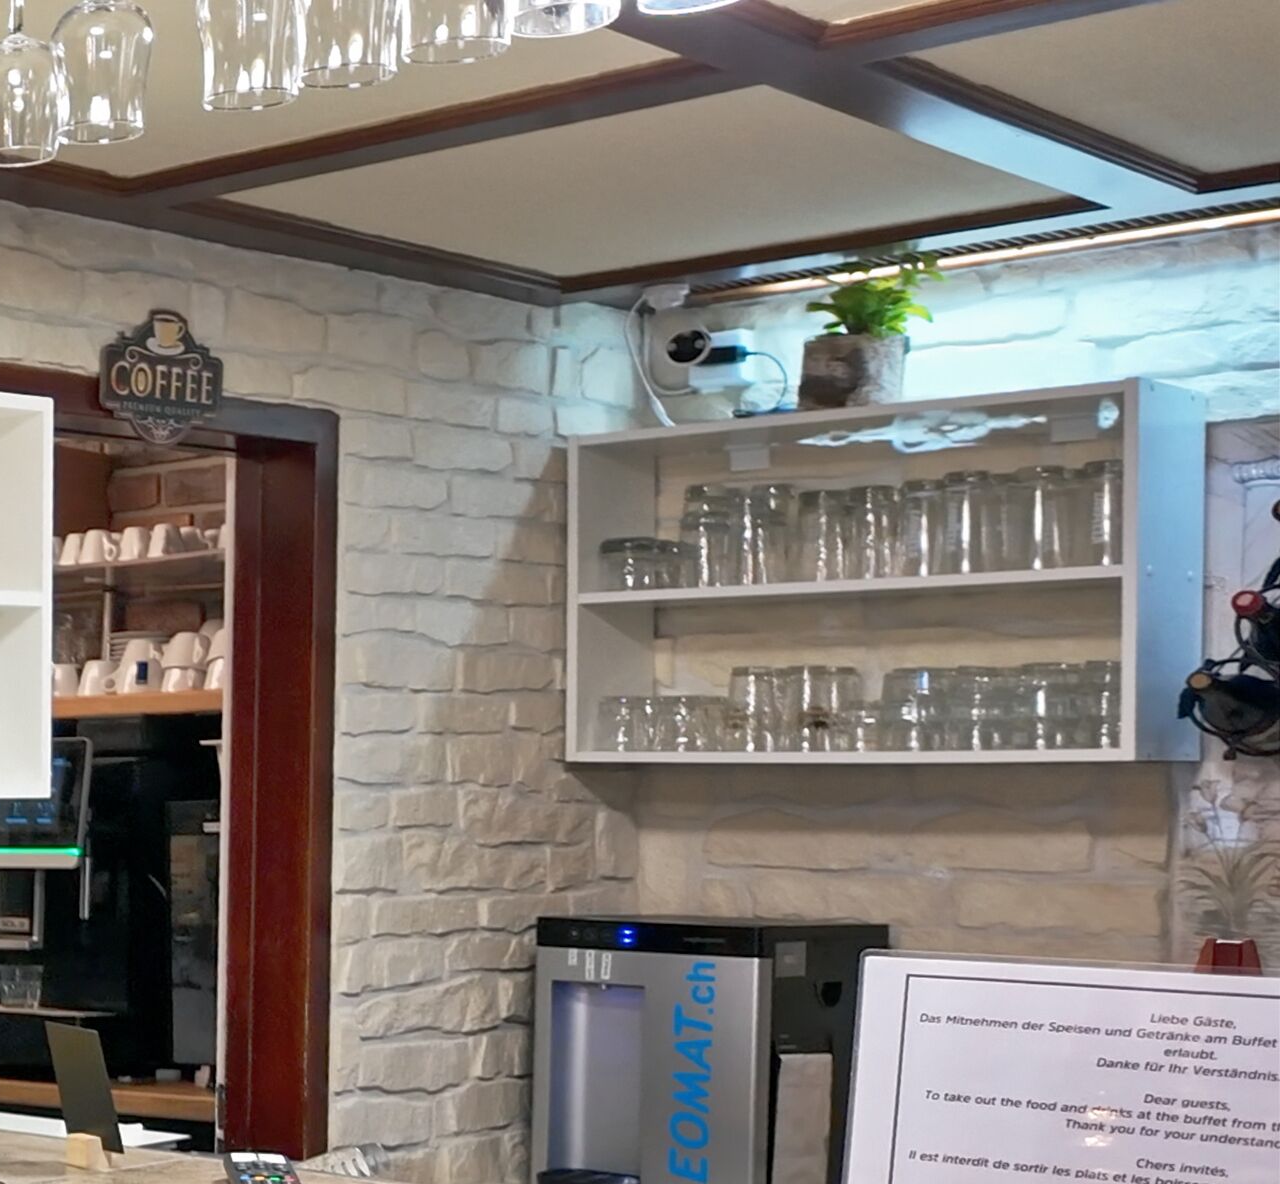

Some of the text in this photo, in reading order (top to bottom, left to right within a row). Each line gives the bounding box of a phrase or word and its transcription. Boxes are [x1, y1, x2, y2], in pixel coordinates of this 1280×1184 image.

[111, 361, 213, 404] COFFEE
[1150, 1013, 1188, 1025] Liebe
[920, 1013, 1278, 1048] Das Mitnehmen der Speisen und Getränke am Buffet
[1163, 1047, 1218, 1061] erlaubt.
[1096, 1057, 1140, 1071] Danke
[1144, 1061, 1165, 1072] für
[1168, 1063, 1188, 1075] Ihr
[925, 1089, 940, 1101] To
[943, 1092, 971, 1104] take
[975, 1096, 997, 1106] out
[1000, 1098, 1022, 1109] the
[1026, 1099, 1057, 1112] food
[1060, 1103, 1087, 1115] and
[1136, 1109, 1151, 1121] at
[1156, 1111, 1179, 1123] the
[1184, 1113, 1228, 1128] buffet
[1231, 1118, 1266, 1131] from
[1143, 1093, 1231, 1112] Dear guests,
[1065, 1118, 1105, 1132] Thank
[1109, 1124, 1135, 1135] you
[1139, 1125, 1160, 1137] for
[1164, 1130, 1197, 1142] your
[919, 1152, 939, 1163] est
[942, 1153, 989, 1168] interdit
[992, 1159, 1010, 1170] de
[1013, 1162, 1049, 1174] sortir
[1052, 1166, 1071, 1177] les
[1074, 1169, 1109, 1182] plats
[1113, 1172, 1127, 1184] et
[1136, 1158, 1175, 1172] Chers
